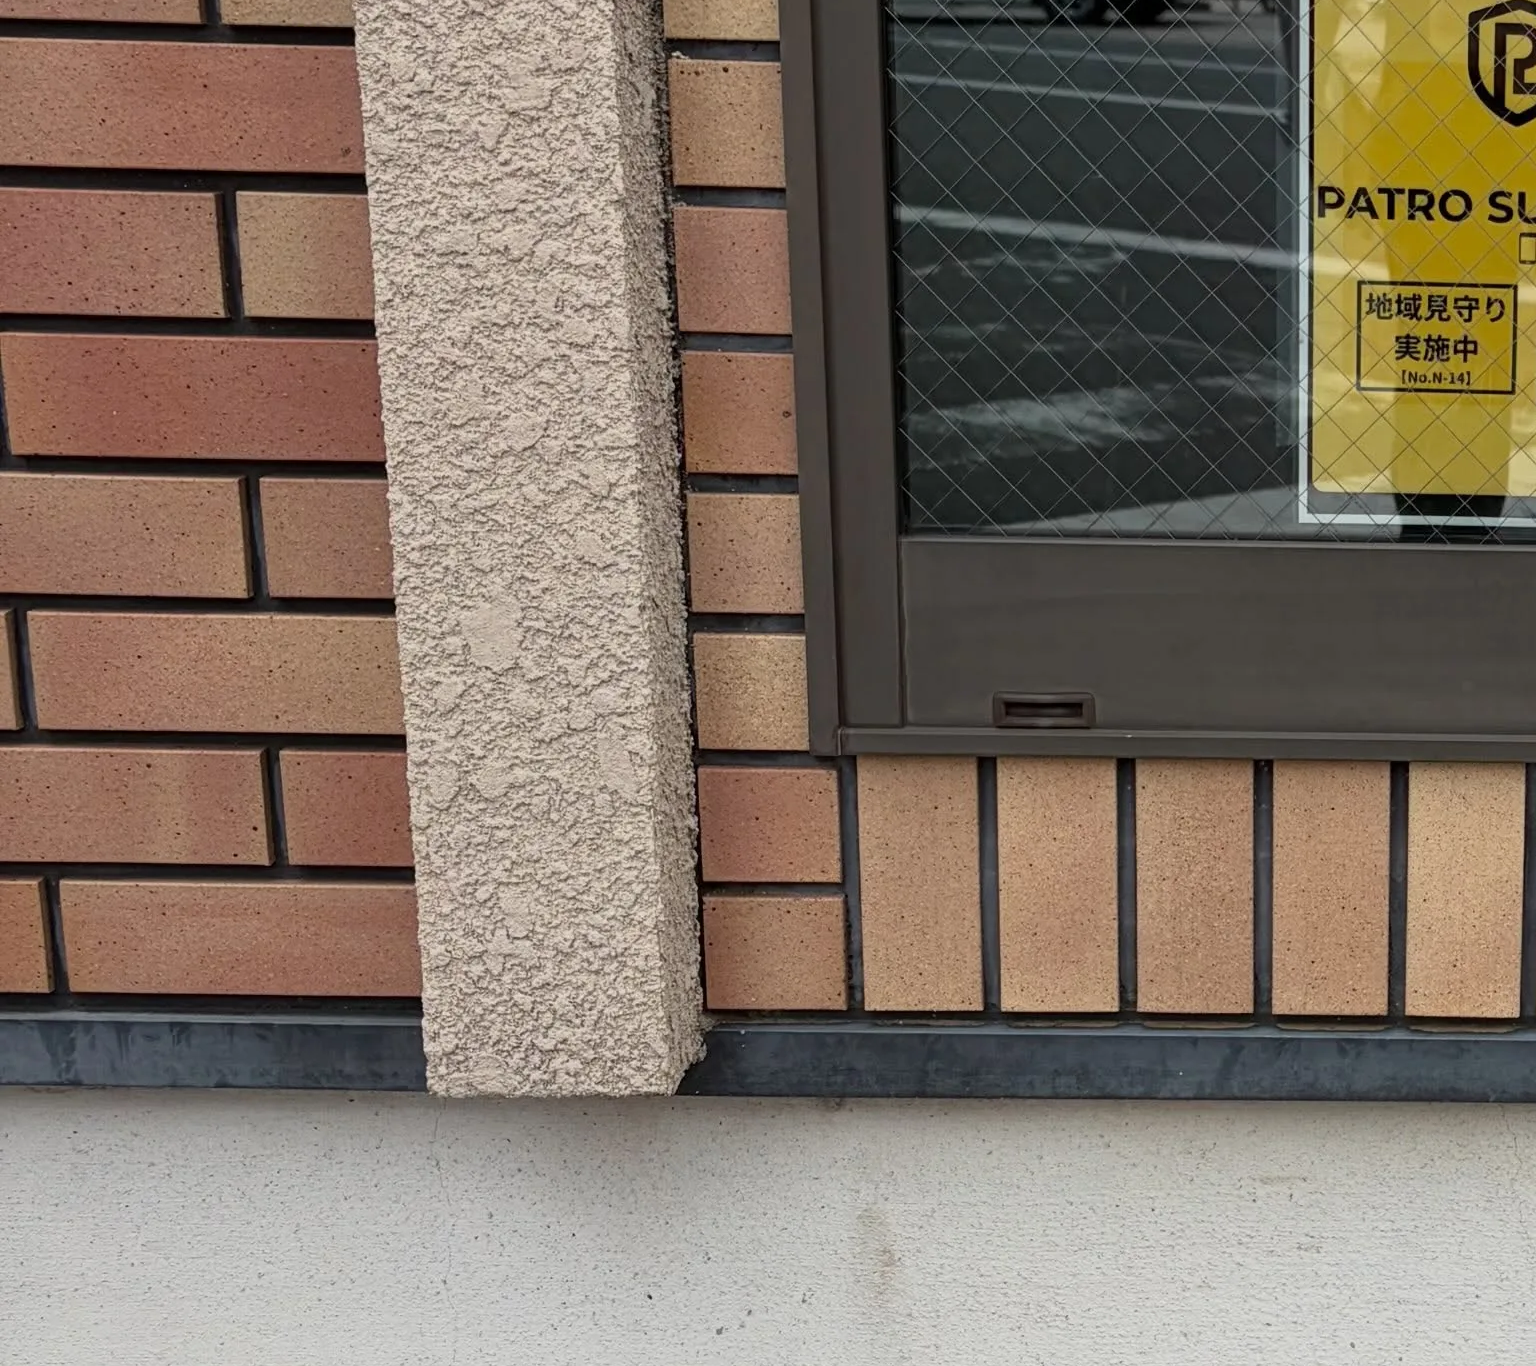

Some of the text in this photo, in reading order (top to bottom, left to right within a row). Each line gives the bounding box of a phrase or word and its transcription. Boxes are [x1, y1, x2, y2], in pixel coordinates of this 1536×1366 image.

[1317, 186, 1473, 225] PATRO
[1364, 293, 1506, 323] 地域見守り
[1393, 334, 1479, 363] 実施中
